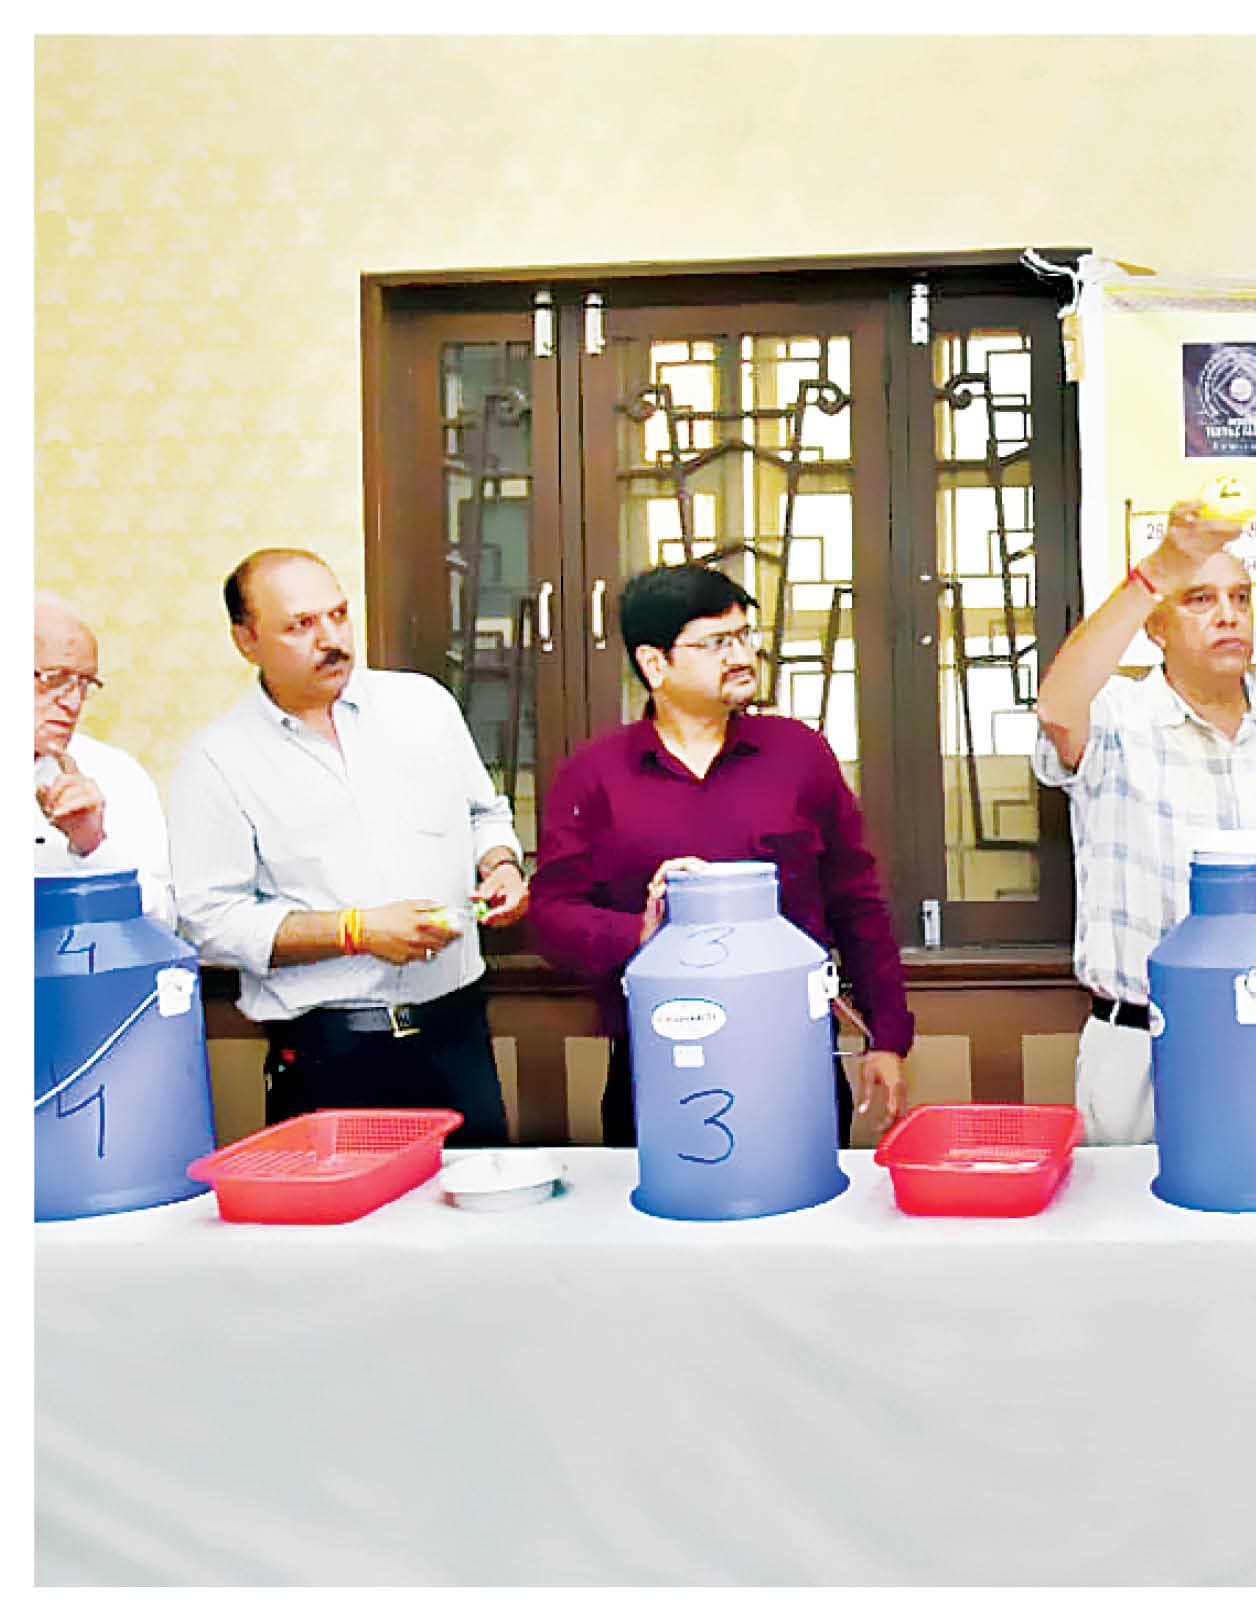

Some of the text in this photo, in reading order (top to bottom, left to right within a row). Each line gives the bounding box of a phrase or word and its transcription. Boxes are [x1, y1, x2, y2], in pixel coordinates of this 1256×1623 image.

[56, 926, 97, 975] 4
[679, 925, 735, 968] 3
[677, 1088, 735, 1165] 3
